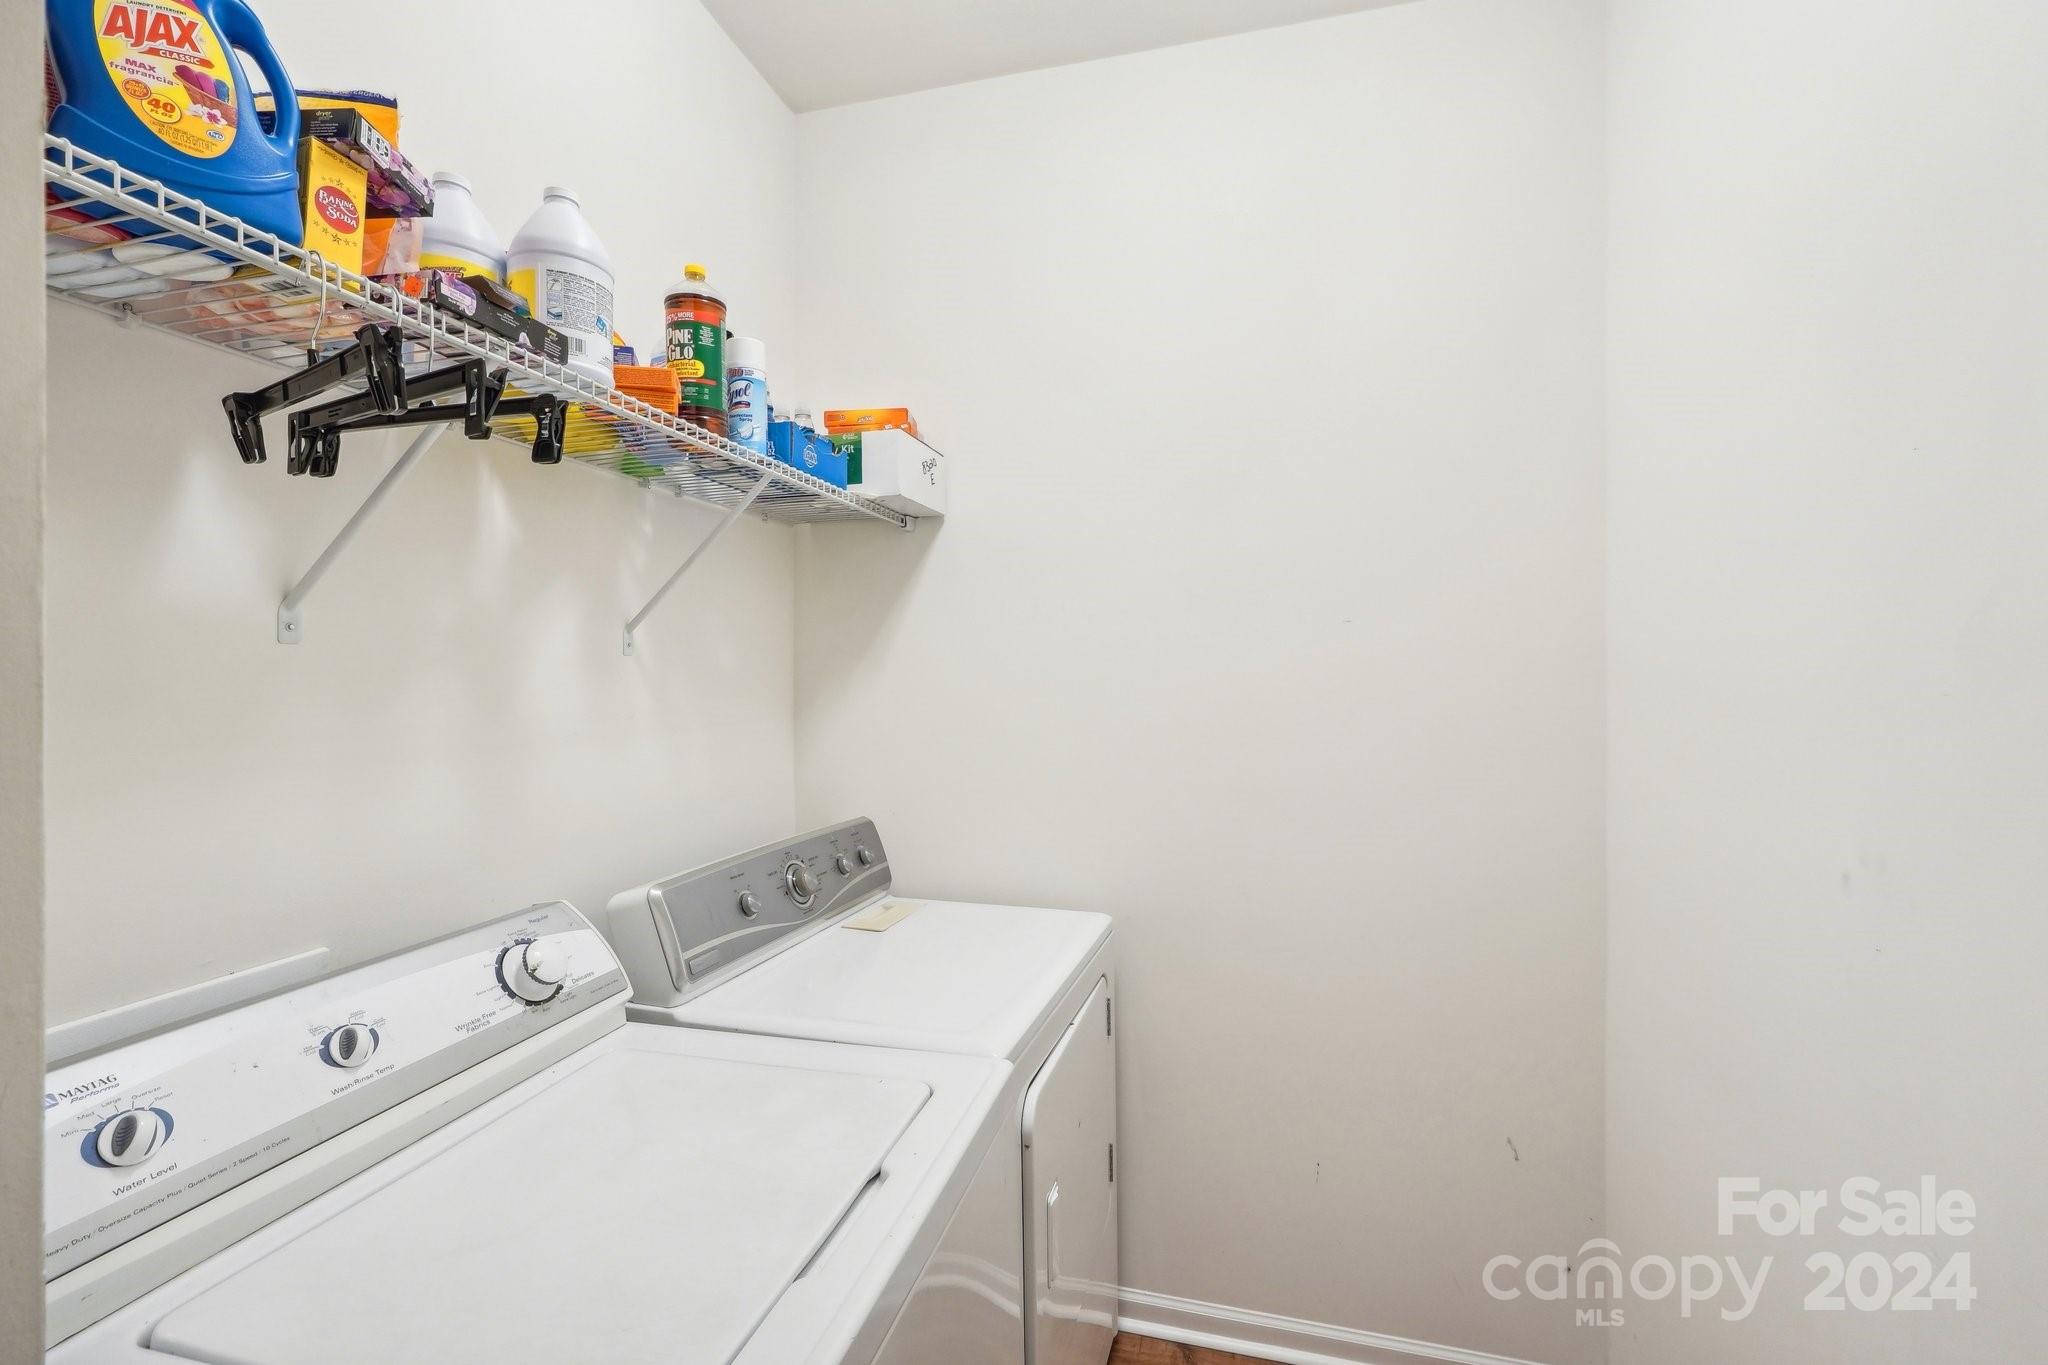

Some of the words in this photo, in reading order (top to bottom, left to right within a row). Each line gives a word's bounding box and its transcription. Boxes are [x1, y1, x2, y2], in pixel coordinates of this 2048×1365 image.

[102, 4, 201, 54] AJAX
[125, 58, 157, 73] MAX
[159, 48, 201, 65] CLASSIC
[147, 98, 176, 113] 40
[319, 189, 355, 210] BAKING
[326, 205, 357, 228] SODA
[678, 311, 694, 319] MORE
[668, 344, 694, 361] GLO
[727, 382, 751, 406] ysol
[841, 444, 855, 454] Kit
[454, 1017, 481, 1032] Wrinkle
[481, 1010, 497, 1020] Free
[465, 1020, 491, 1034] Fabrics
[375, 1062, 396, 1076] Temp
[58, 1073, 118, 1101] MAYTAG
[70, 1083, 120, 1105] Performa
[112, 1177, 147, 1197] Water
[150, 1162, 178, 1180] Level
[71, 1232, 92, 1247] Duty
[97, 1214, 131, 1233] Oversize
[133, 1197, 165, 1216] Capacity
[166, 1188, 183, 1198] Plus
[187, 1176, 206, 1189] Quiet
[207, 1166, 228, 1179] Series
[271, 1136, 291, 1148] Cycles
